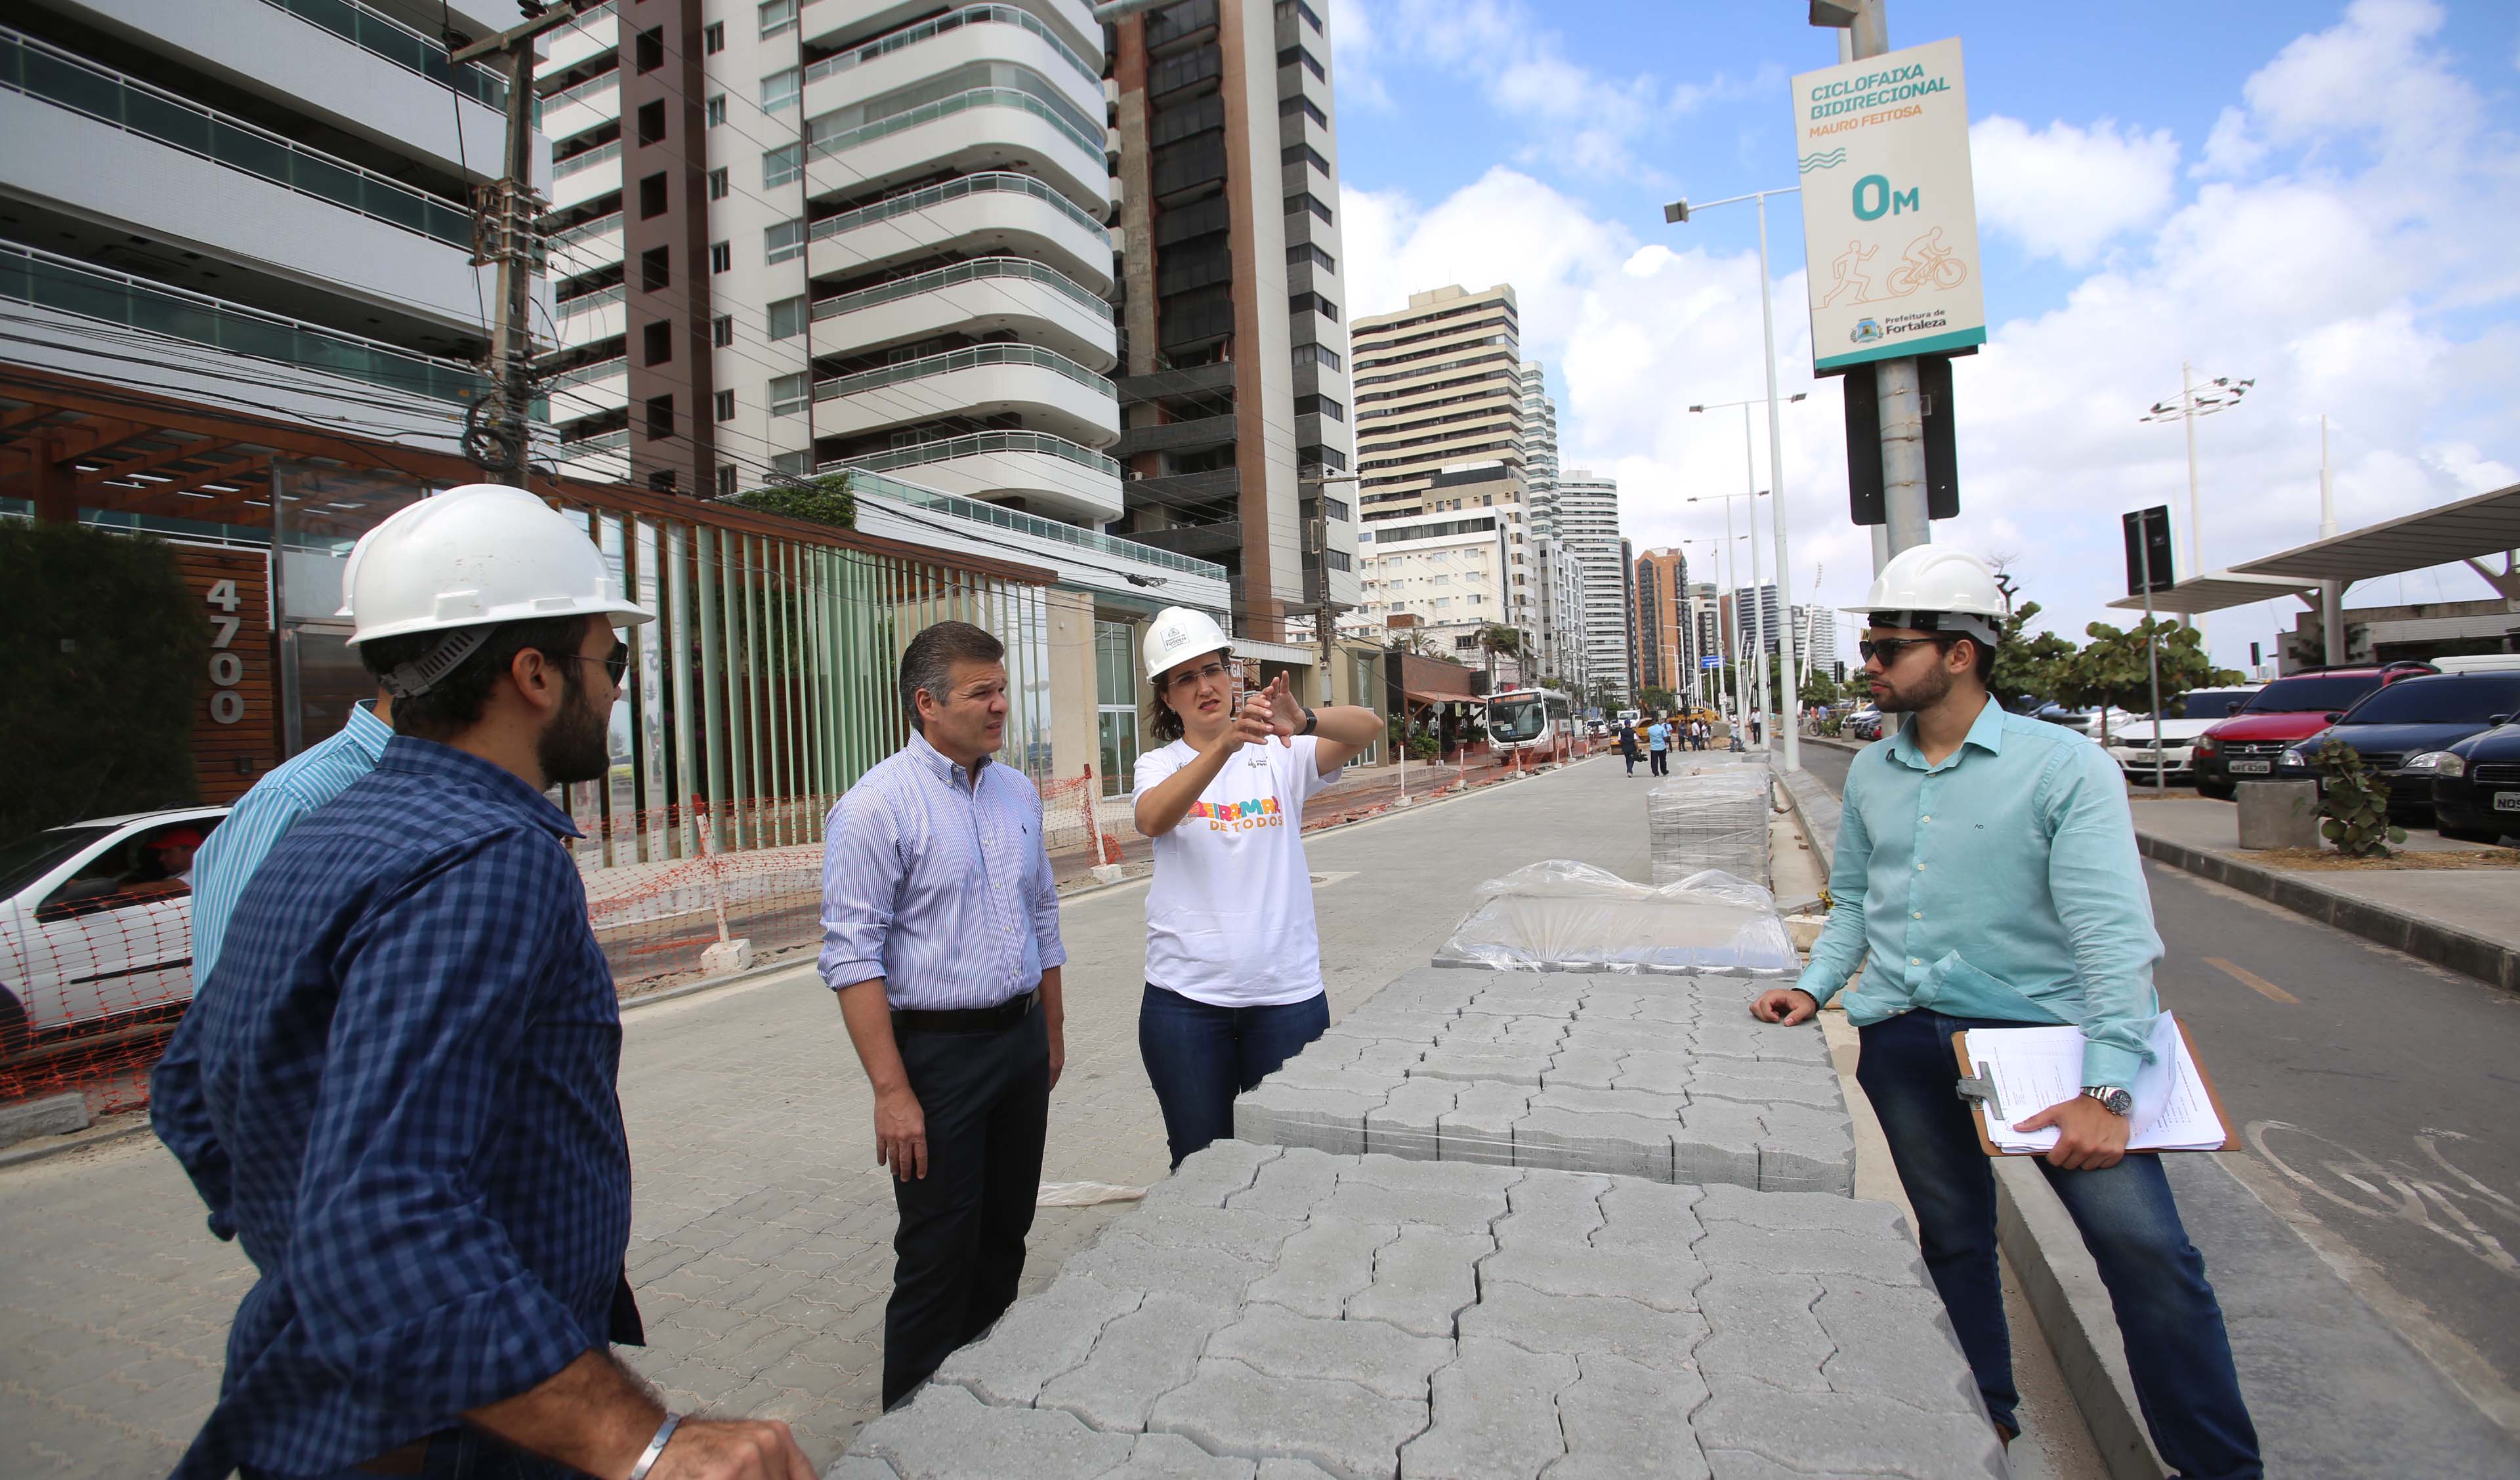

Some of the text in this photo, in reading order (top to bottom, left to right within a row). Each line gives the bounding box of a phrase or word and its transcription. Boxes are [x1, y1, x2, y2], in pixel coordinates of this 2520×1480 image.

[1811, 63, 1924, 102] CICLOFAIXA
[1811, 76, 1951, 120] BIDIRECIONAL
[1809, 104, 1923, 138] MAURO FEITOSA
[1885, 312, 1931, 324] Prefeitura
[1886, 319, 1946, 335] Fortaleza
[207, 579, 245, 724] 4700
[1209, 820, 1228, 832] DE
